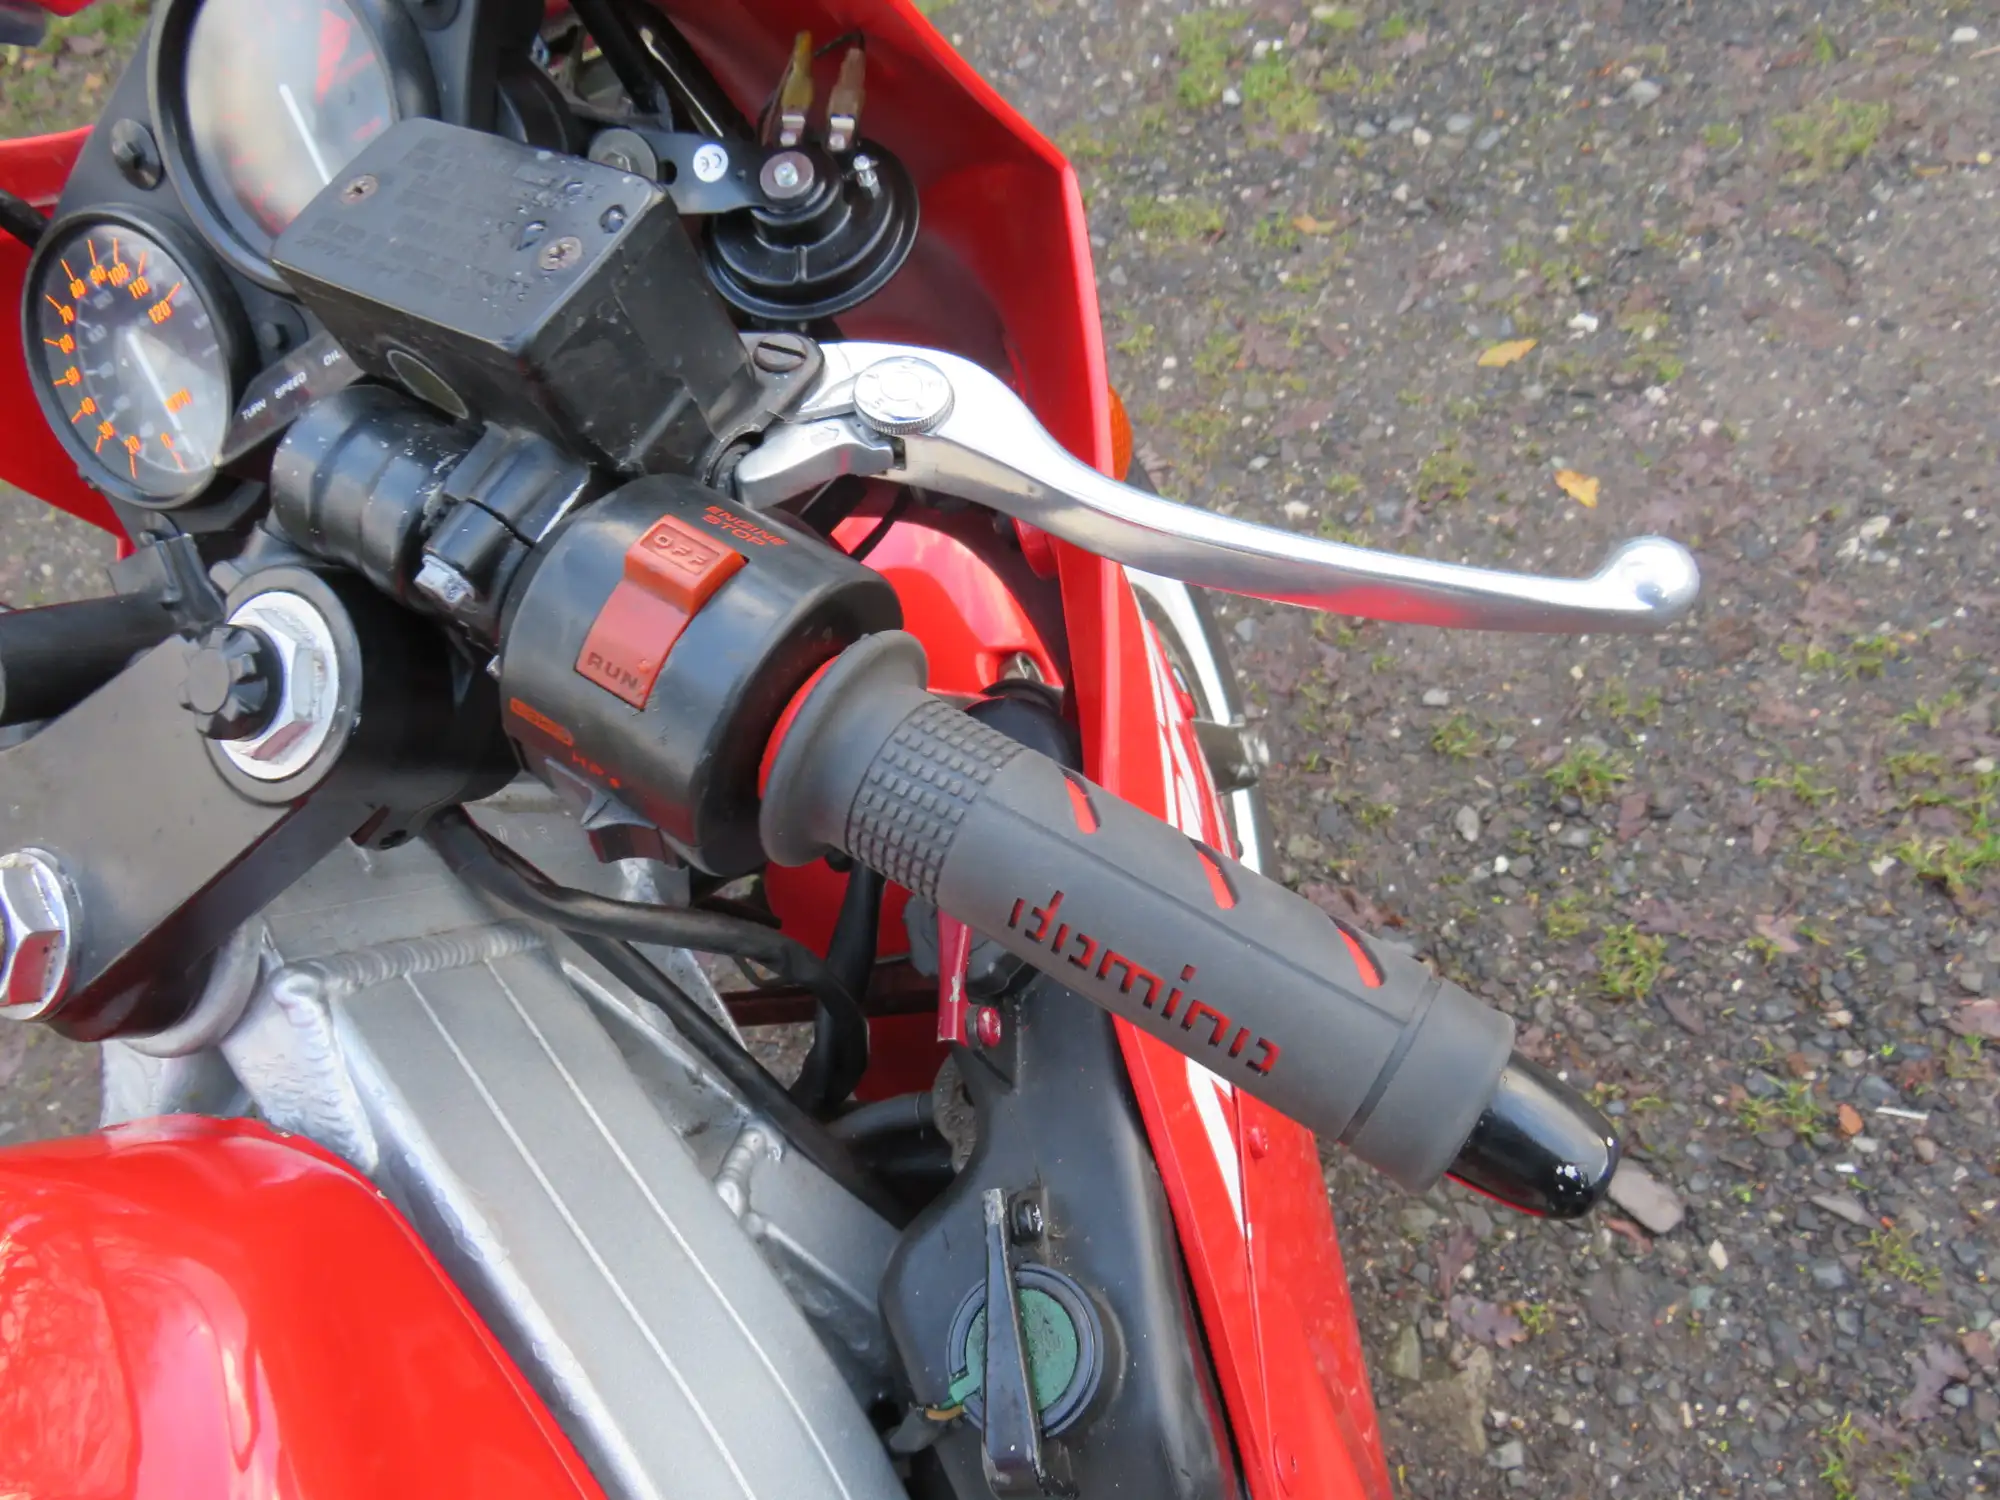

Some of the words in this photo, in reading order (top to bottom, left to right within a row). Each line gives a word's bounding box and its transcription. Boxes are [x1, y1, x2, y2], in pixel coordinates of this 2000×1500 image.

[90, 264, 106, 285] 90
[108, 263, 129, 286] 100
[128, 276, 150, 299] 110
[148, 300, 172, 324] 120
[323, 350, 341, 367] OIL
[275, 371, 307, 399] SPEED
[242, 398, 267, 420] TURN
[702, 513, 767, 546] STOP
[704, 505, 789, 546] ENGINE
[653, 533, 706, 567] OFF
[587, 652, 640, 690] RUN
[1008, 890, 1280, 1077] domino
